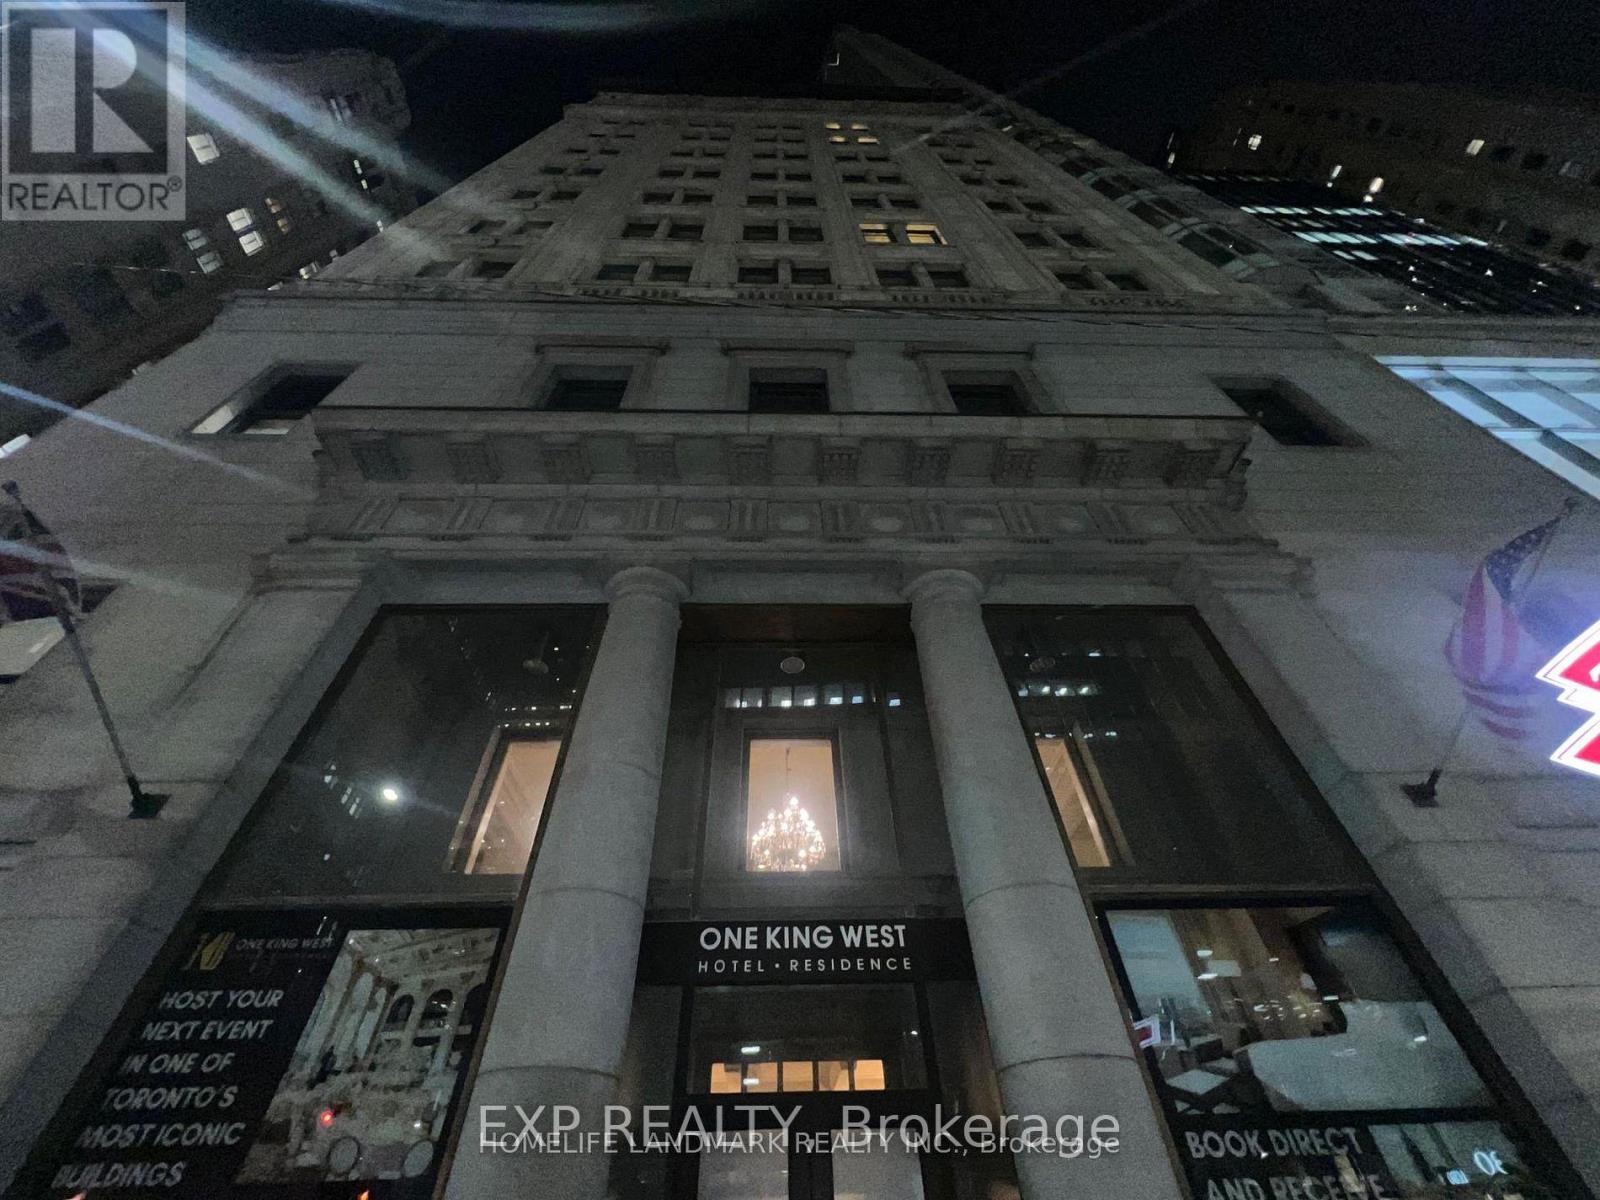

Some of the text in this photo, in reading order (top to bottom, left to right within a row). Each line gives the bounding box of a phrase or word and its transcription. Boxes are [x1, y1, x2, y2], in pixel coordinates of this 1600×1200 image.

[236, 938, 264, 950] ONE
[266, 938, 299, 949] KING
[700, 924, 906, 950] ONE KING WEST
[698, 957, 912, 973] HOTEL RESIDENCE
[160, 988, 284, 1010] HOST YOUR
[142, 1019, 274, 1041] NEXT EVENT
[119, 1052, 236, 1075] IN ONE OF
[102, 1085, 239, 1111] TORONTO'S
[74, 1121, 247, 1149] MOST ICONIC
[1185, 1127, 1363, 1159] BOOK DIRECT
[51, 1160, 187, 1189] BUILDINGS
[1207, 1177, 1266, 1200] AND
